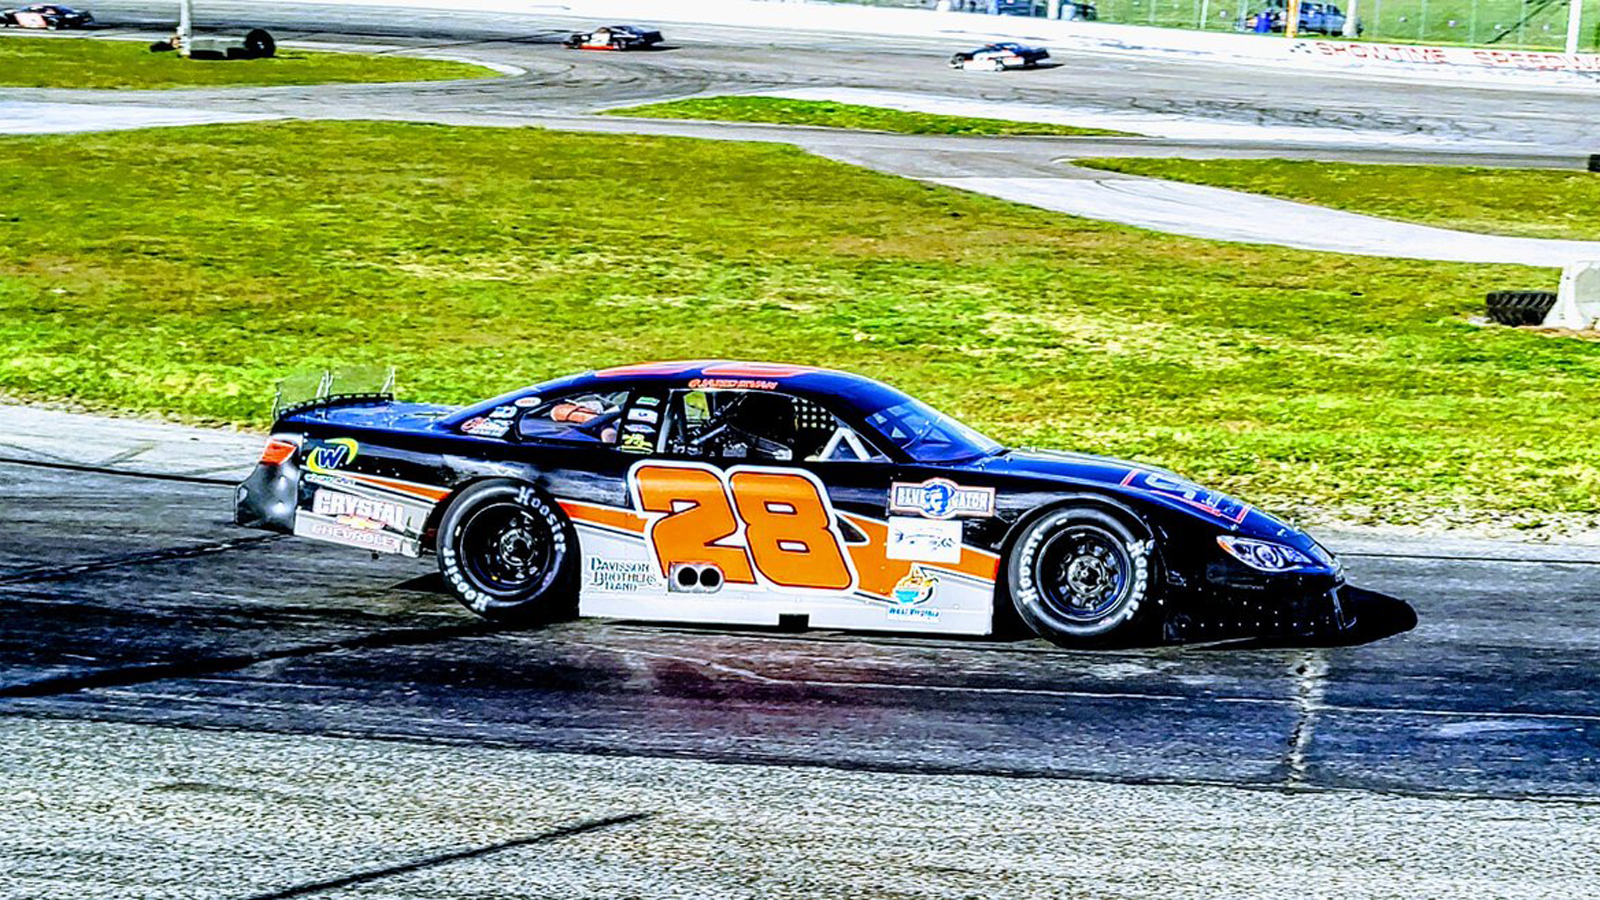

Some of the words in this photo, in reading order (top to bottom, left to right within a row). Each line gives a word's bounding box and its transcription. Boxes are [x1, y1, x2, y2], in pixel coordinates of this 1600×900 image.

[1315, 41, 1447, 65] SHOWTIME
[315, 488, 406, 532] CRYSTAL
[312, 523, 403, 552] CHEVROLET
[630, 461, 857, 594] 28
[591, 557, 649, 572] DAVISSON
[589, 571, 657, 586] BROTHERS
